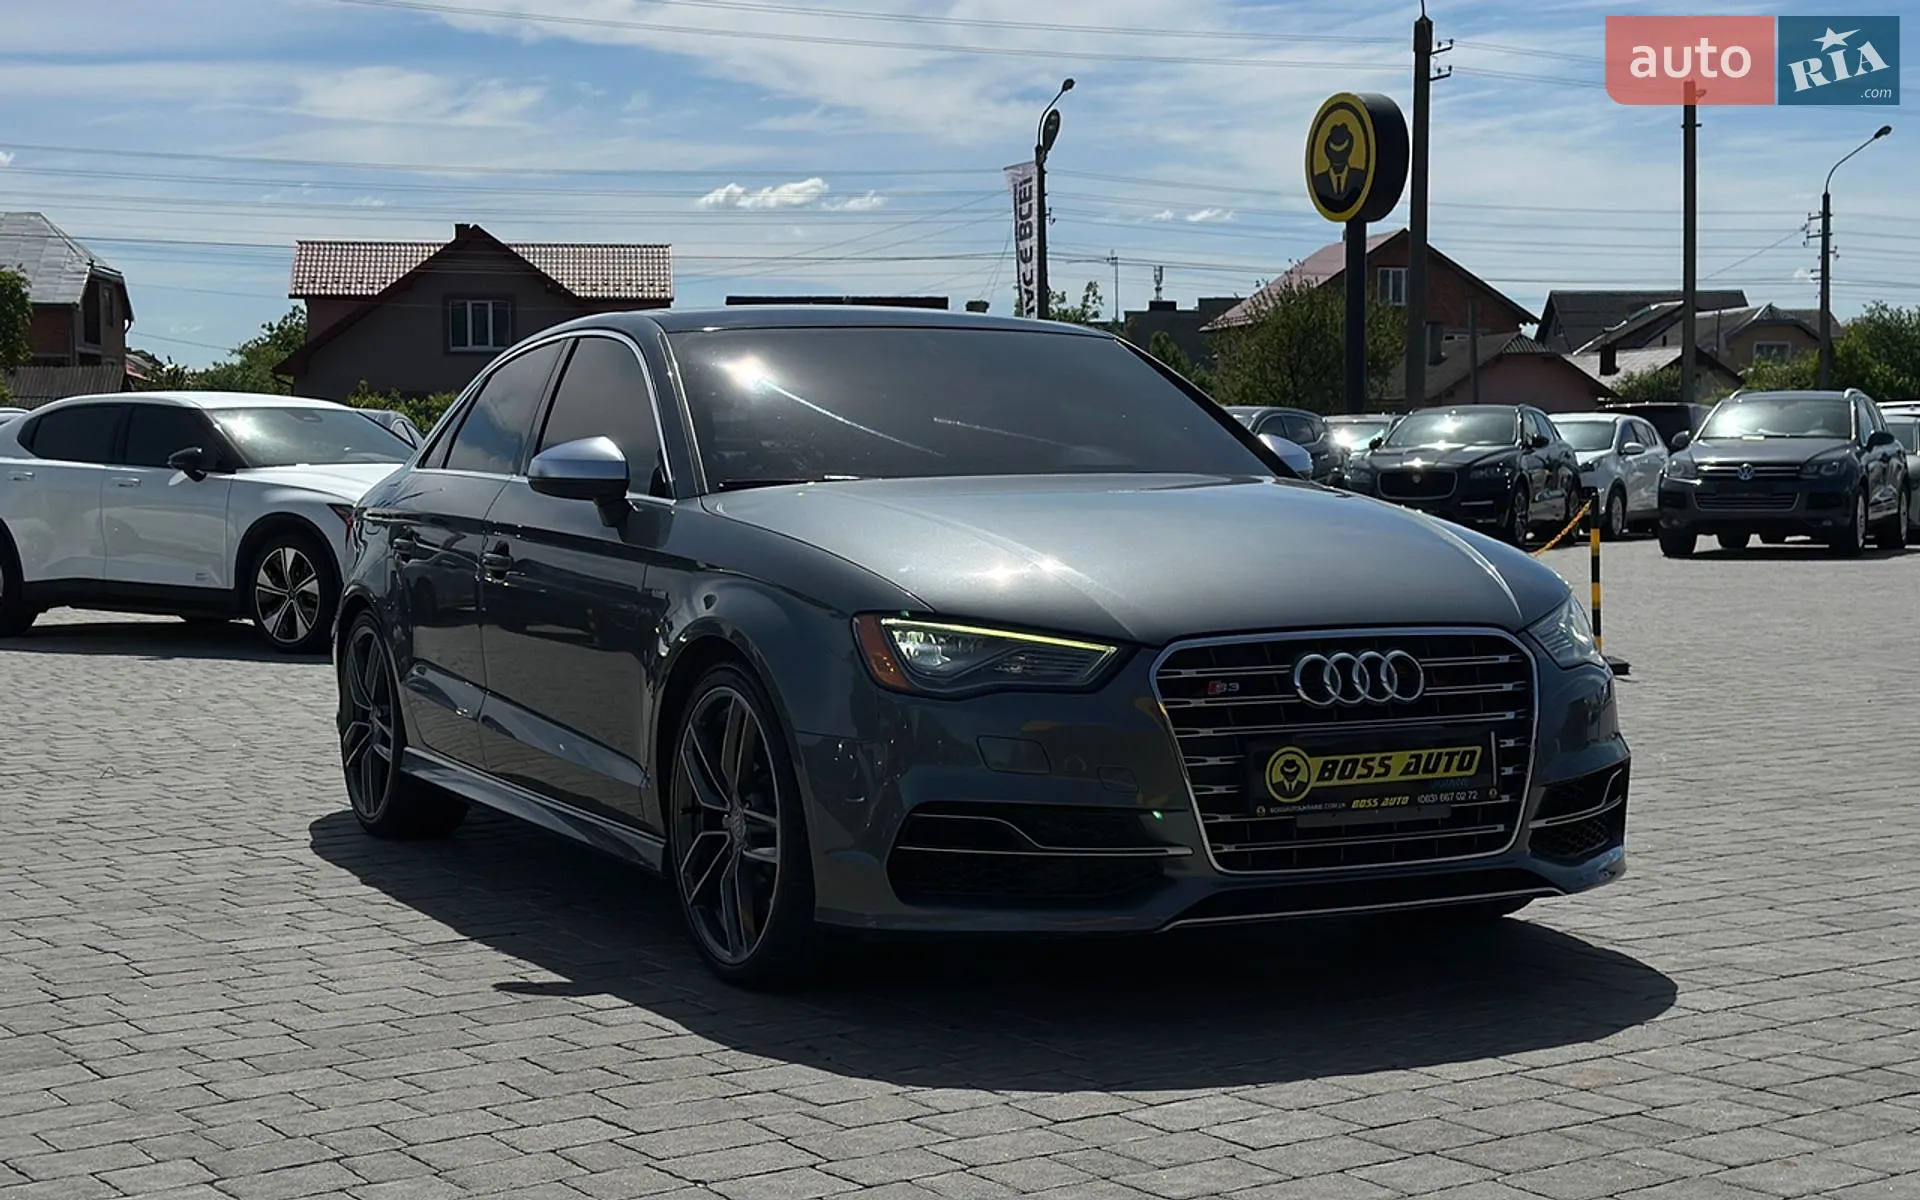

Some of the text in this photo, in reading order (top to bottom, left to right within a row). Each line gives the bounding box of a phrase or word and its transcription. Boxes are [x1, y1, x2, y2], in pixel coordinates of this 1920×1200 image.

[1316, 749, 1478, 782] BOSS AUTO
[1351, 798, 1379, 809] BOSS
[1380, 796, 1410, 807] AUTO
[1468, 790, 1478, 800] 72
